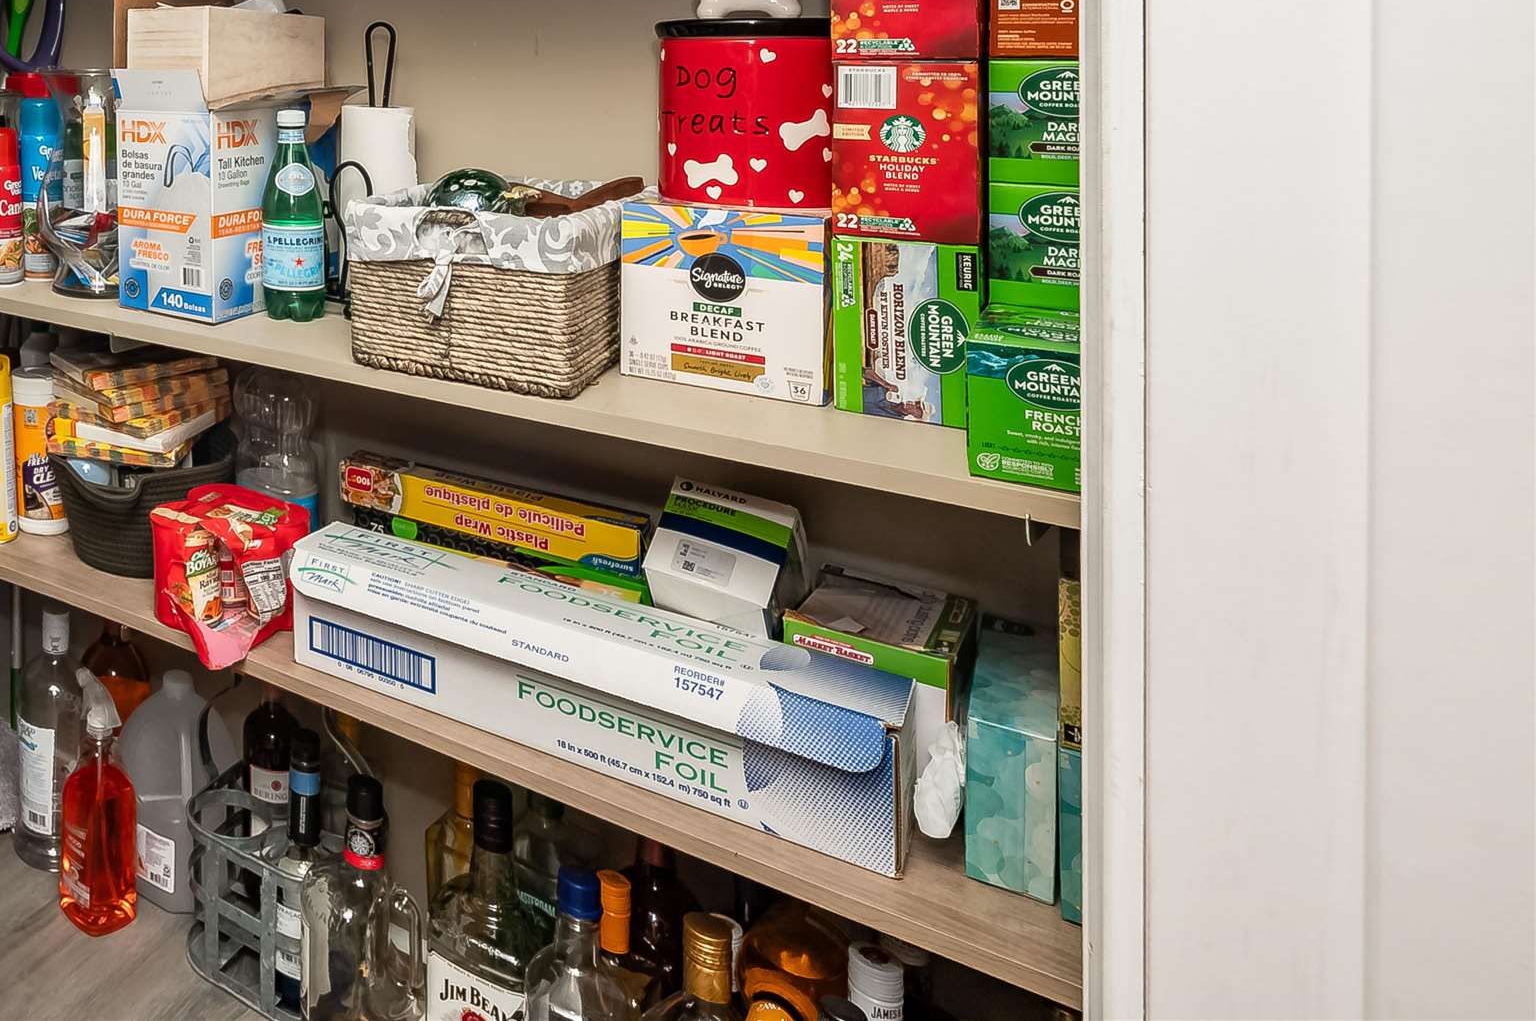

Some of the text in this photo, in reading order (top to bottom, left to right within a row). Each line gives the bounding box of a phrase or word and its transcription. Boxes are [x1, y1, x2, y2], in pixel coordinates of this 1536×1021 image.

[836, 39, 857, 54] 22
[675, 65, 737, 98] Dog
[121, 120, 166, 145] HDX
[661, 110, 769, 135] Treats
[217, 119, 259, 149] HDX
[121, 149, 149, 160] Bolsas
[122, 160, 163, 170] de basura
[218, 155, 265, 170] Tall Kitchen
[869, 155, 937, 165] STARBUCKS
[122, 171, 155, 181] grandes
[880, 164, 925, 172] HOLIDAY
[885, 172, 919, 180] BLEND
[123, 208, 151, 220] DURA
[153, 212, 190, 225] FORCE
[218, 214, 246, 227] DURA
[837, 214, 858, 228] 22
[133, 241, 161, 251] AROMA
[137, 249, 169, 261] FRESCO
[837, 243, 853, 262] 24
[691, 267, 744, 288] Signature
[963, 255, 972, 290] KEURIG
[161, 292, 206, 313] 140 Bolsas
[700, 304, 734, 314] DECAF
[670, 311, 765, 332] BREAKFAST
[893, 283, 906, 380] HORIZON BLEND
[690, 327, 744, 343] BLEND
[928, 305, 941, 367] MOUNTAIN
[941, 316, 954, 358] GREEN
[793, 386, 807, 395] 36
[675, 495, 736, 516] PROCEDURE
[696, 486, 747, 504] HALYARD
[424, 486, 585, 536] Pellicule de plastique
[454, 513, 549, 551] Plastic Wrap
[357, 533, 433, 556] FIRST
[311, 558, 345, 573] FIRST
[371, 572, 402, 585] CAUTION!
[497, 576, 749, 653] FOODSERVICE
[511, 638, 570, 664] STANDARD
[649, 629, 738, 663] FOIL
[795, 634, 834, 655] MARKET
[673, 665, 726, 687] REORDER#
[673, 676, 724, 701] 157547
[518, 679, 729, 769] FOODSERVICE
[557, 739, 567, 749] 18
[584, 750, 599, 761] 500
[600, 754, 606, 763] ft
[608, 757, 628, 771] (45.7
[629, 766, 643, 777] cm
[692, 788, 709, 800] 750
[710, 795, 722, 806] sq
[723, 797, 731, 808] ft
[655, 750, 728, 794] FOIL
[440, 979, 466, 1002] JIM
